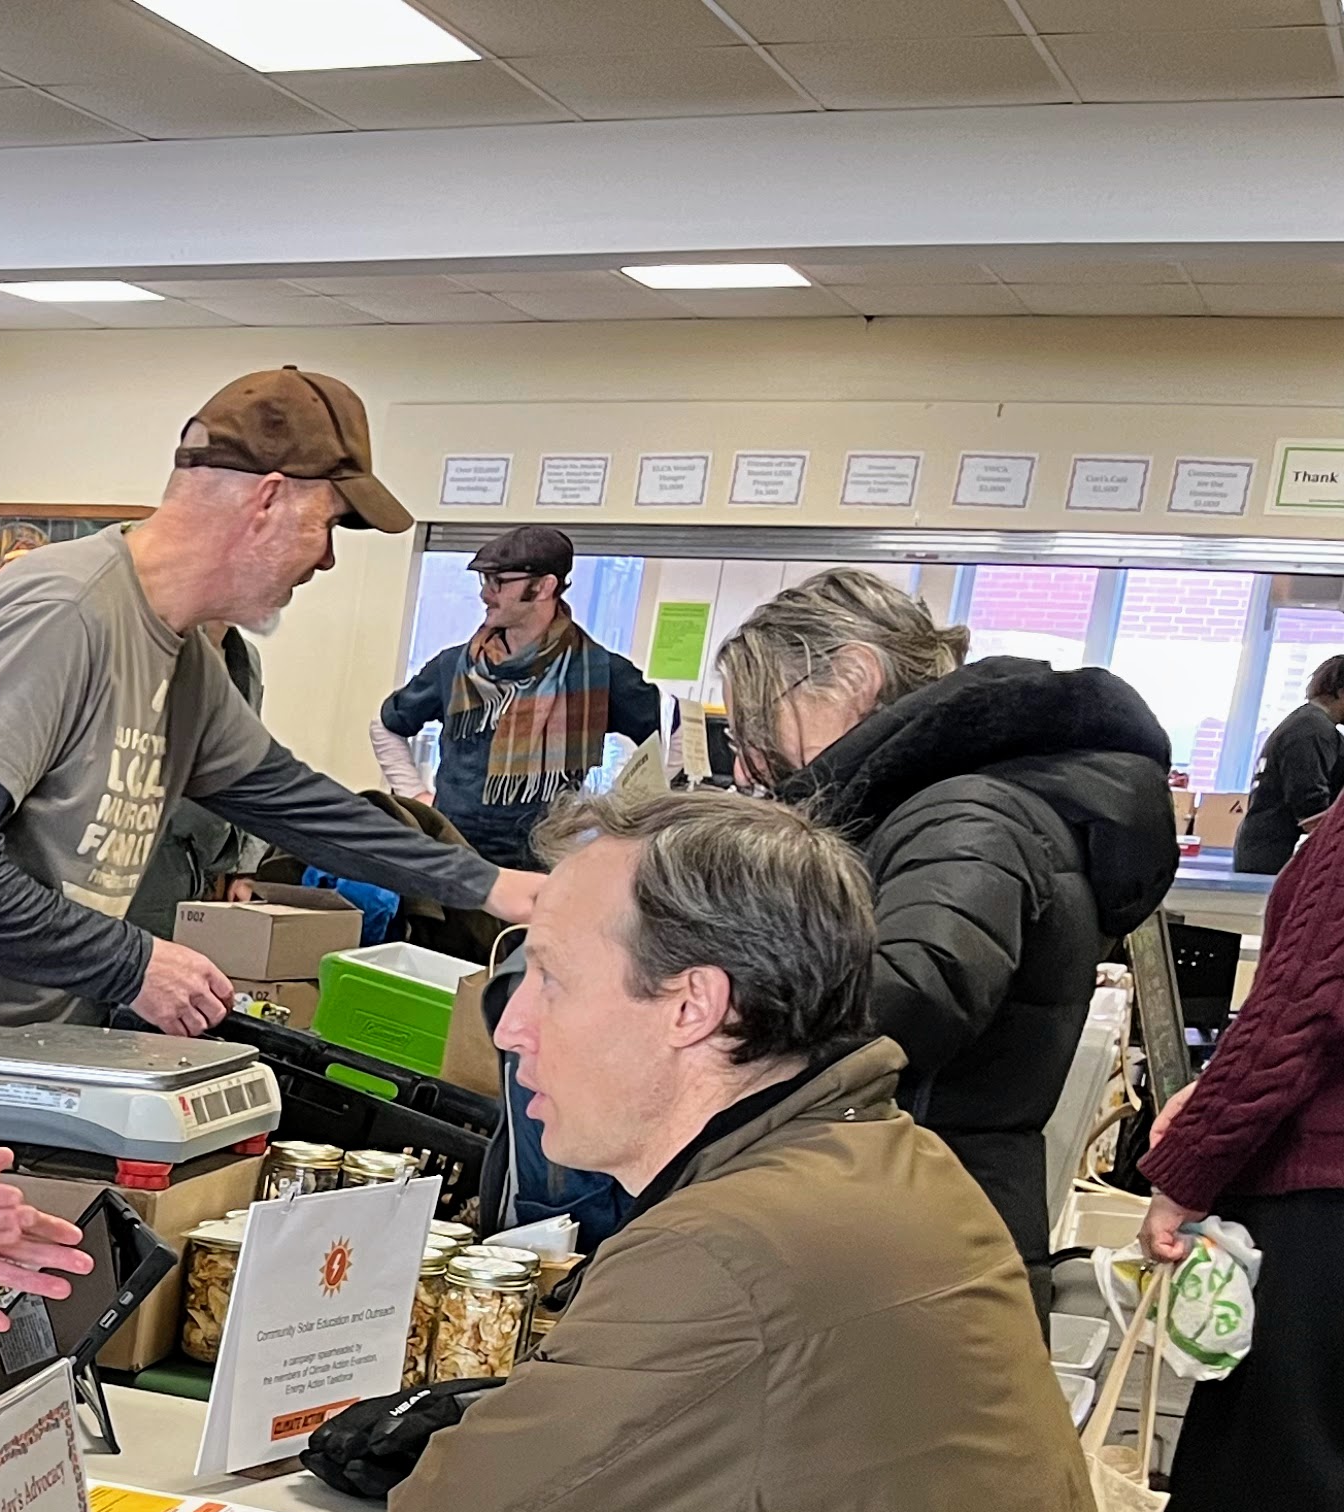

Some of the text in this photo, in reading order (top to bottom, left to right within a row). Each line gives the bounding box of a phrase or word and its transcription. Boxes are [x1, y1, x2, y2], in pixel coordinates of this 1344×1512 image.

[1293, 470, 1340, 484] Thank
[180, 910, 205, 923] 1 DOZ
[257, 1305, 395, 1342] Community Solar Education and Outreach
[288, 1353, 316, 1366] campaign
[318, 1345, 353, 1361] spearheaded
[354, 1343, 362, 1353] by
[263, 1376, 272, 1385] the
[273, 1370, 301, 1383] members
[302, 1366, 308, 1377] of
[309, 1364, 331, 1376] Climate
[332, 1359, 350, 1369] Action
[285, 1382, 305, 1395] Energy
[307, 1378, 326, 1390] Action
[274, 1416, 301, 1435] CLIMATE
[24, 1461, 66, 1505] Advocacy
